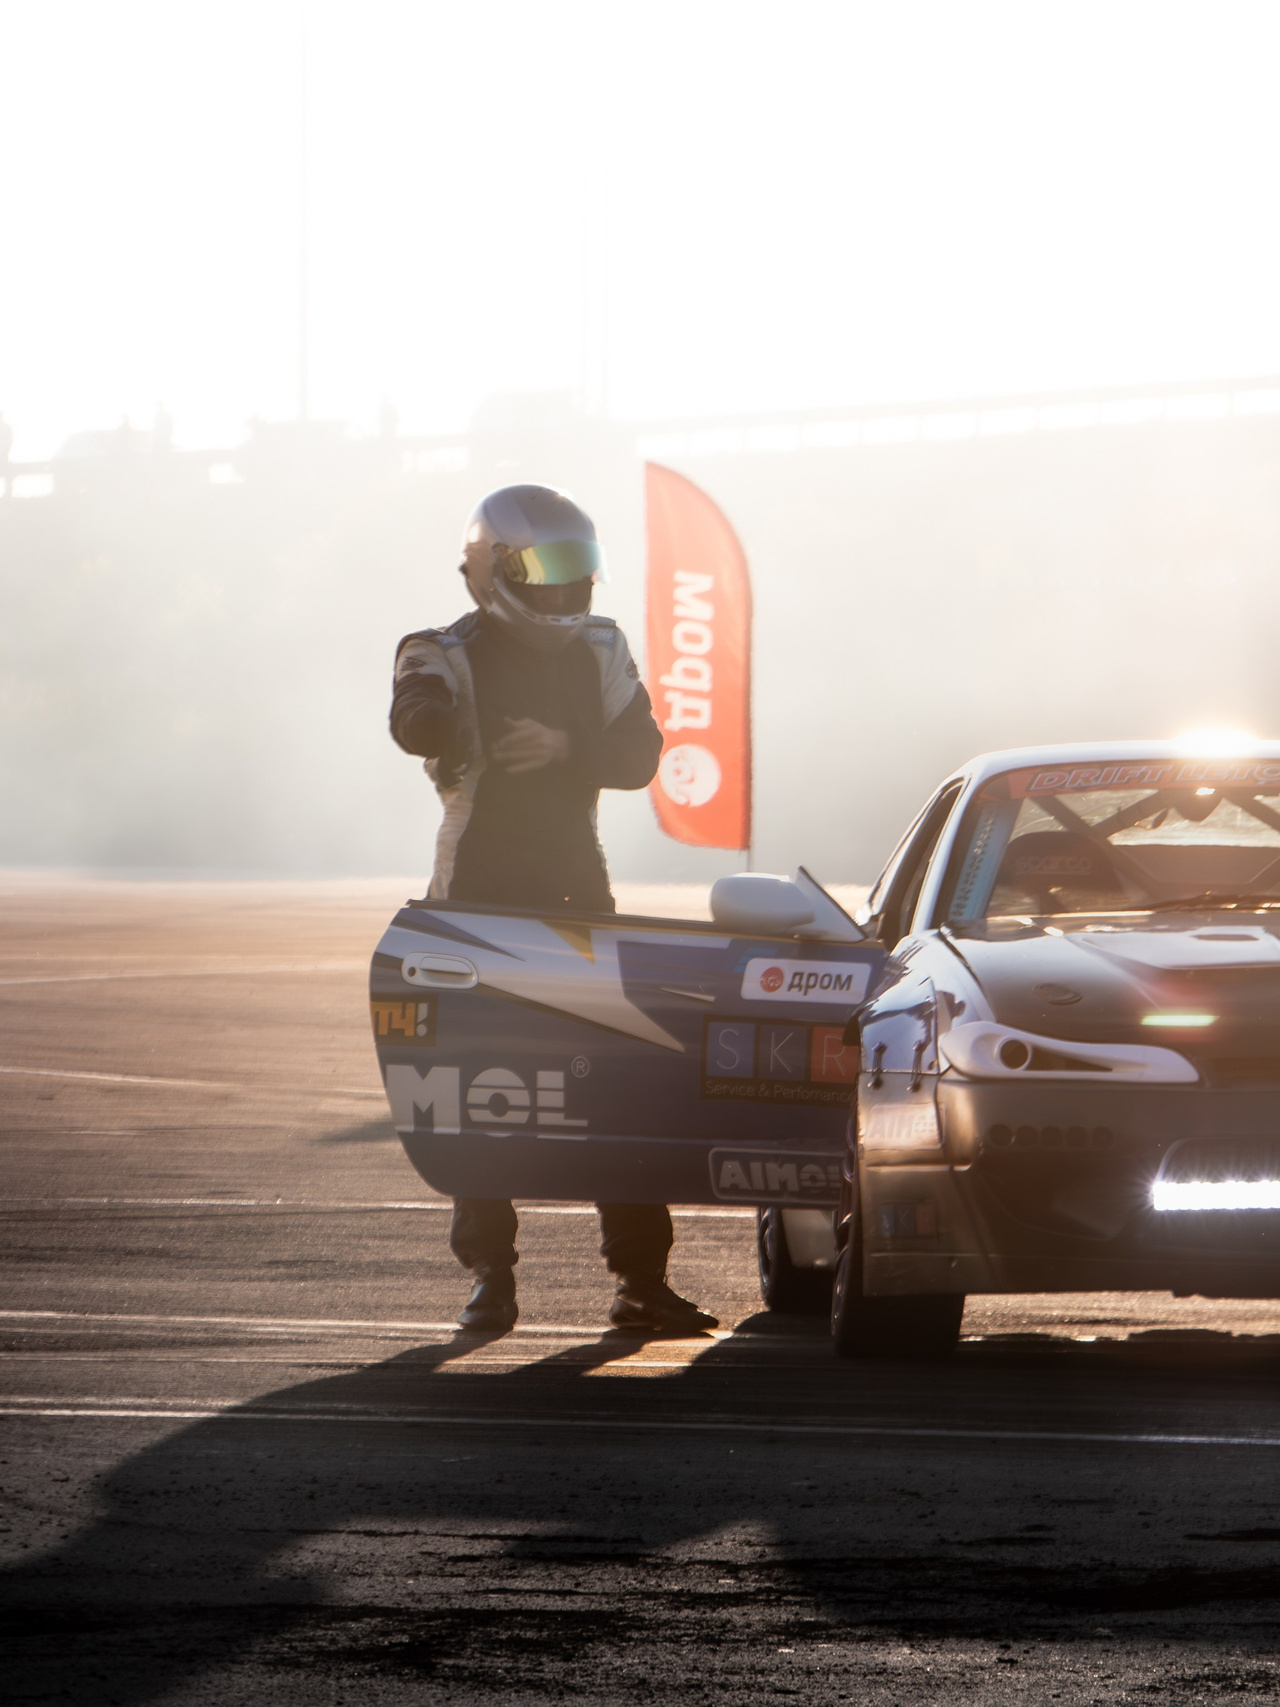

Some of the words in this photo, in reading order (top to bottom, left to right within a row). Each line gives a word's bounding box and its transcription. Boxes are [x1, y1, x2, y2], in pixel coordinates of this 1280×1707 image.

[1029, 764, 1174, 792] DRIFT
[786, 971, 854, 996] дром
[716, 1028, 846, 1077] SKR
[705, 1080, 755, 1097] Service
